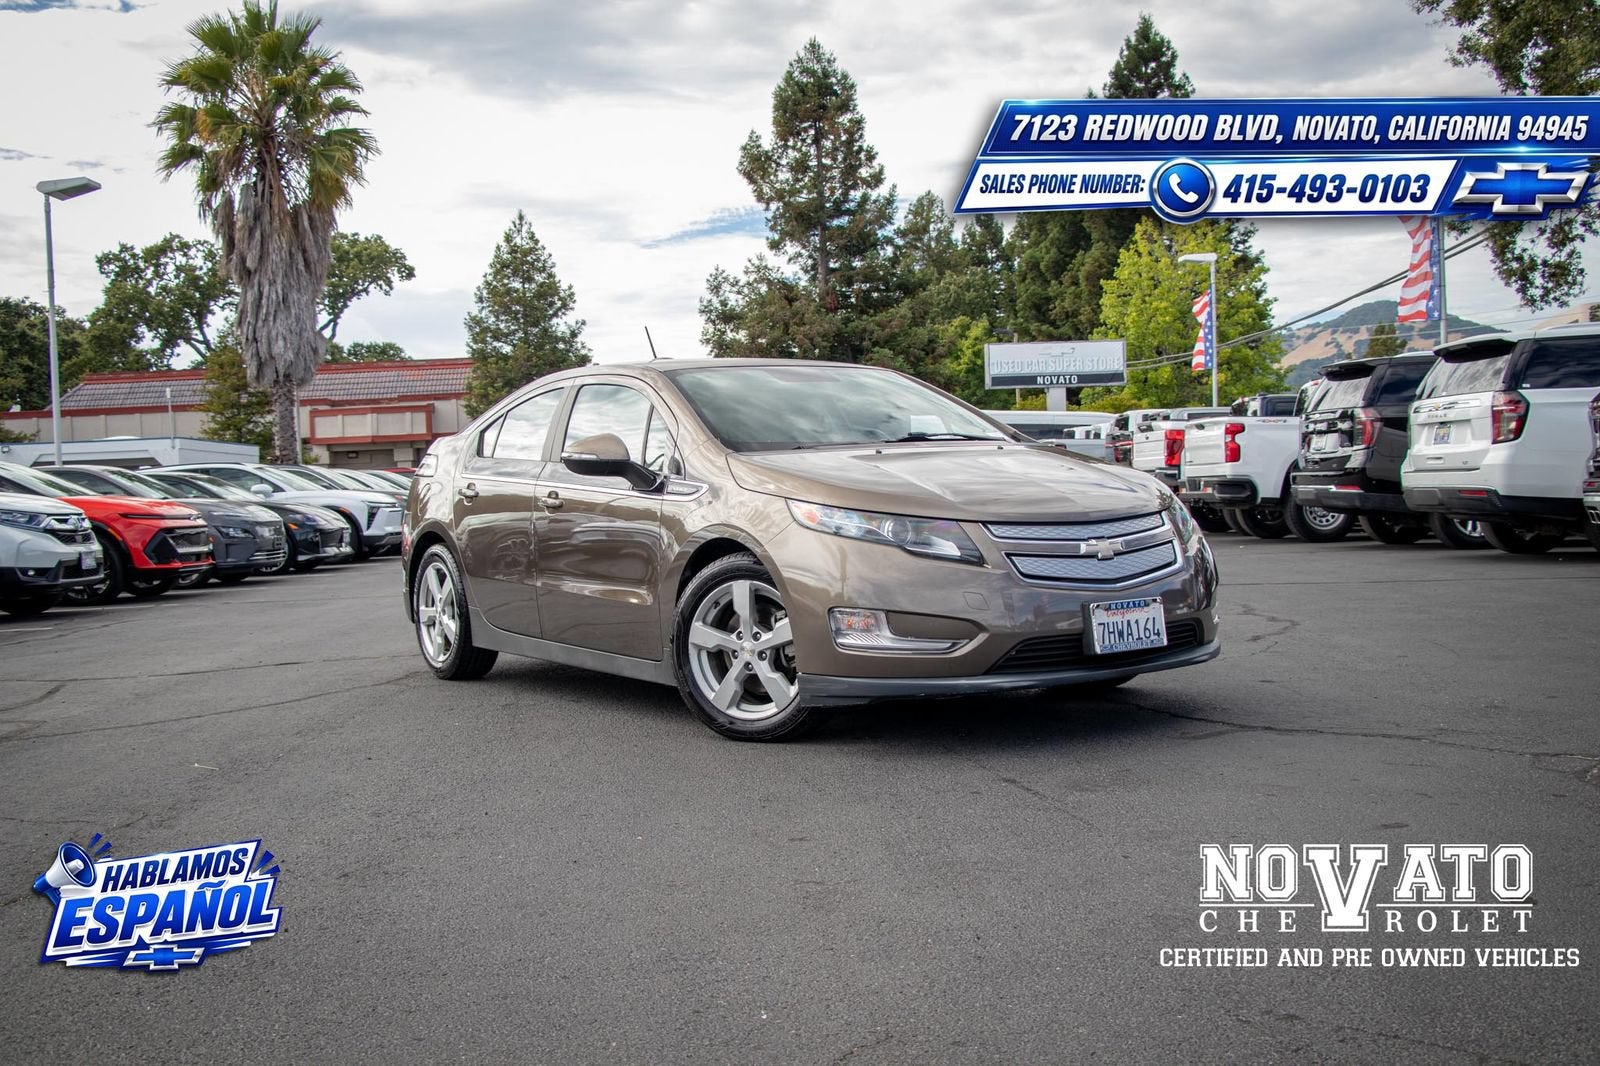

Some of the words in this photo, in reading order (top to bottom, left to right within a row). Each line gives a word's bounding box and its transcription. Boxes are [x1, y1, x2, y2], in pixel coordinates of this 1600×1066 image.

[994, 360, 1022, 373] USED
[1024, 359, 1046, 372] CAR
[1047, 357, 1083, 371] SUPER
[1085, 356, 1120, 369] STORE
[1037, 375, 1078, 385] NOVATO
[1110, 602, 1145, 610] NOVATO
[1097, 617, 1161, 644] 7HWA164
[1112, 640, 1151, 651] CHEVROLET
